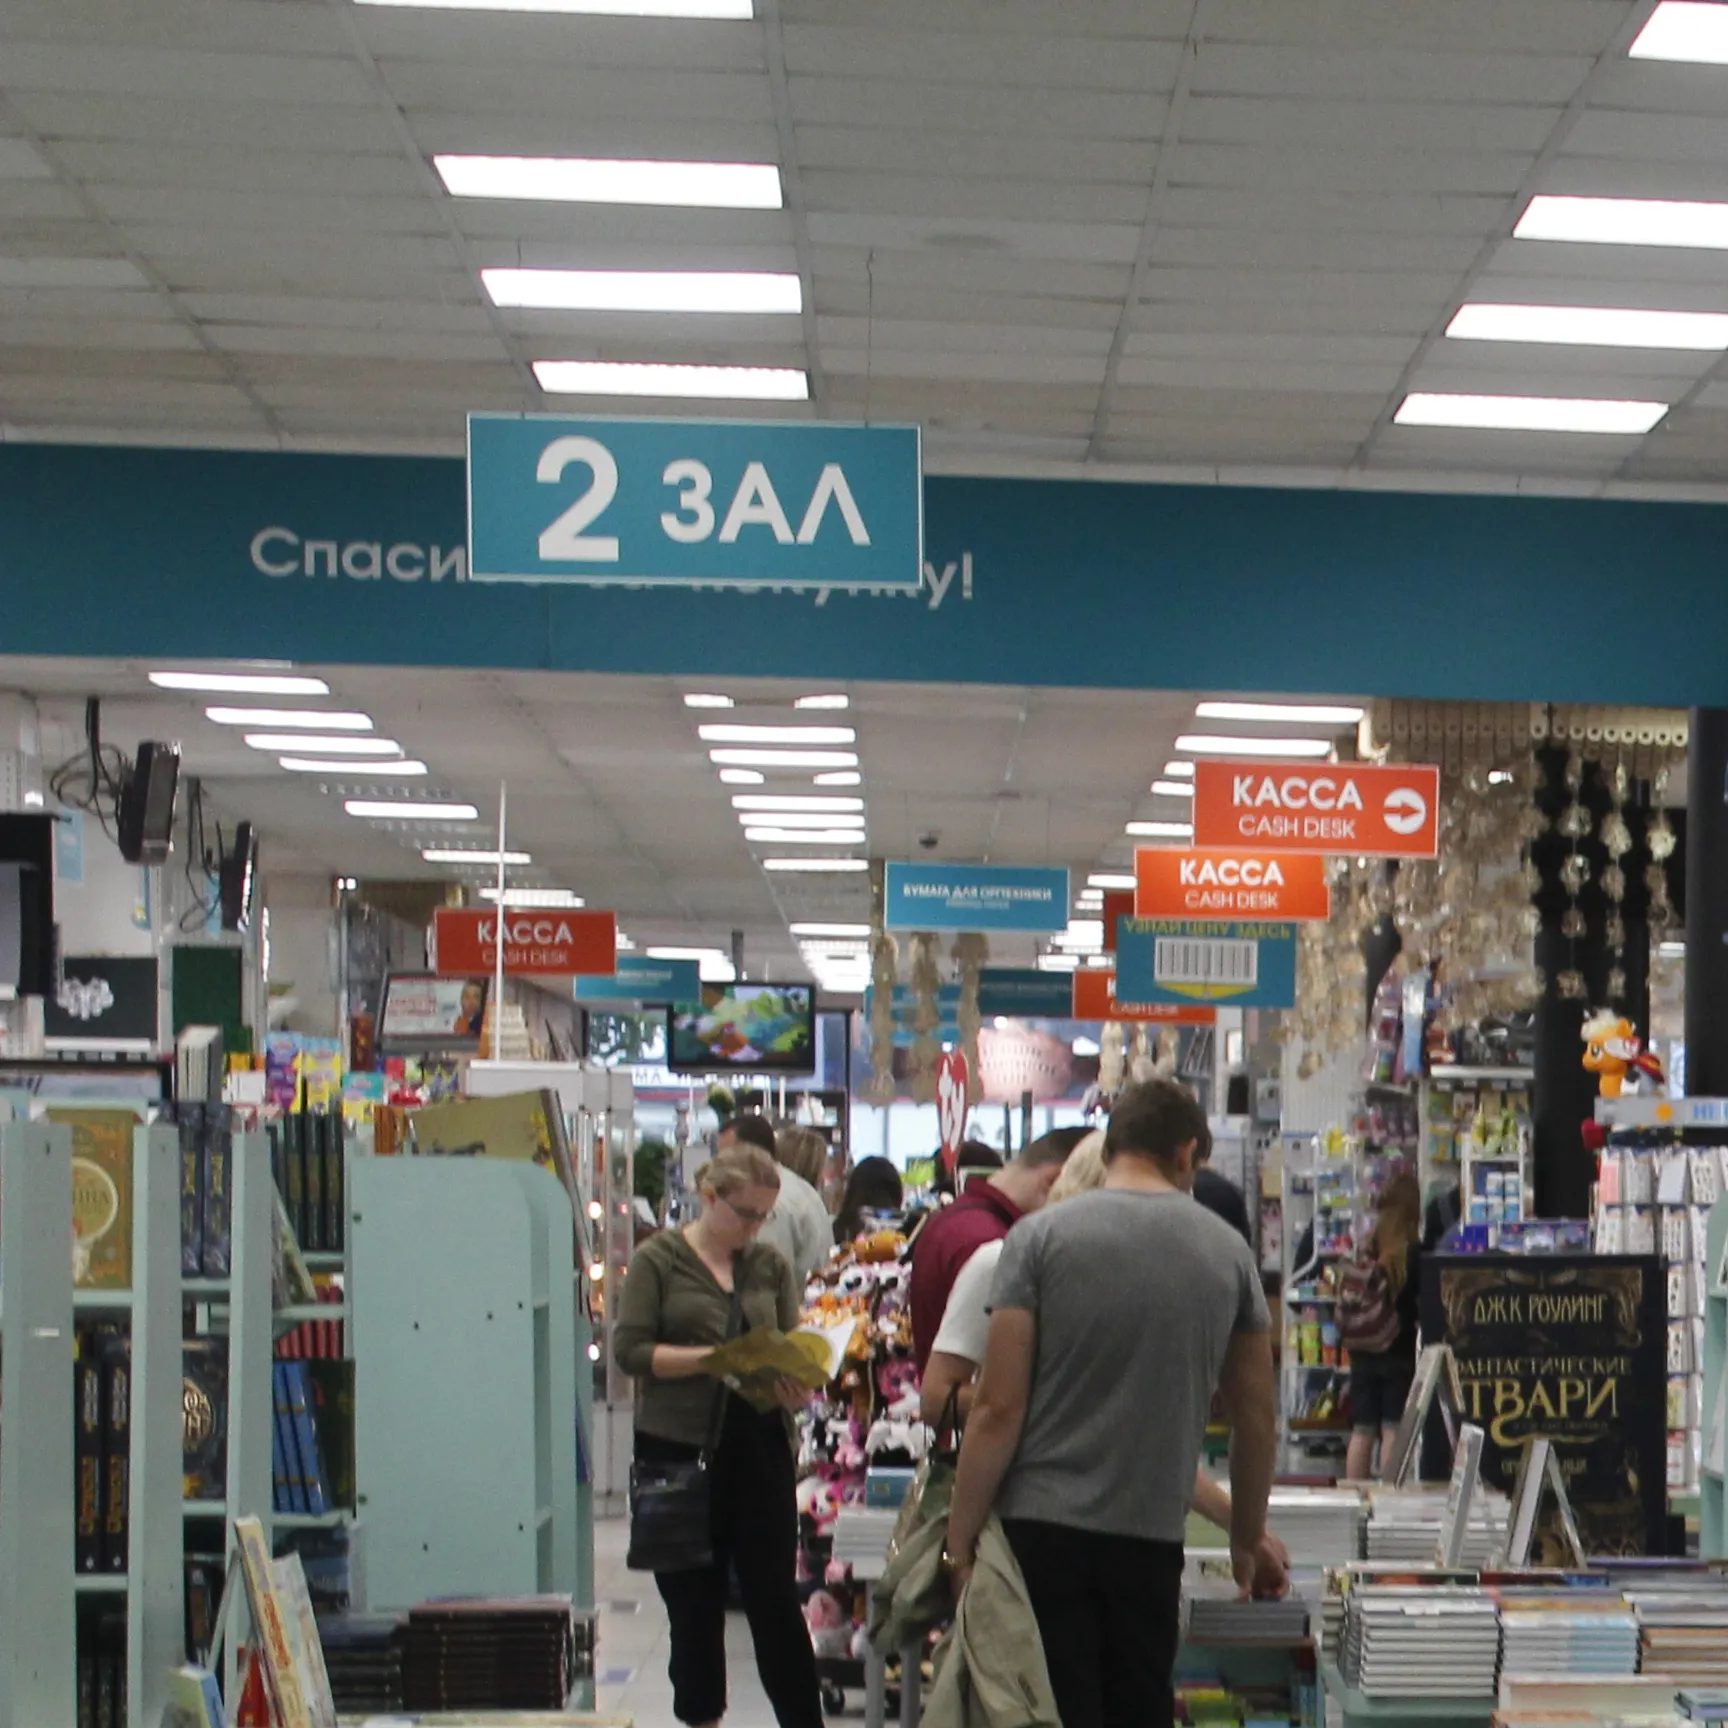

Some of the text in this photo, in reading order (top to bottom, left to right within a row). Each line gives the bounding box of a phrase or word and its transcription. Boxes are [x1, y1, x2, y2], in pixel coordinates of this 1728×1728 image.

[535, 436, 871, 562] 2 ЗАЛ
[250, 527, 470, 584] Спаси
[1232, 775, 1363, 812] КАССА
[1239, 815, 1357, 840] CASH DESK
[1179, 859, 1284, 887] КАССА
[903, 883, 949, 898] БУМАГА
[1185, 890, 1278, 909] CASH DESK
[476, 919, 573, 947] КАССА
[1184, 921, 1232, 938] ЦЕНУ
[1236, 922, 1291, 940] ЗДЕСЬ
[482, 948, 569, 967] CASH DESK
[1528, 1293, 1609, 1324] РОУЛИНГ
[1461, 1377, 1620, 1421] ТВАРИ
